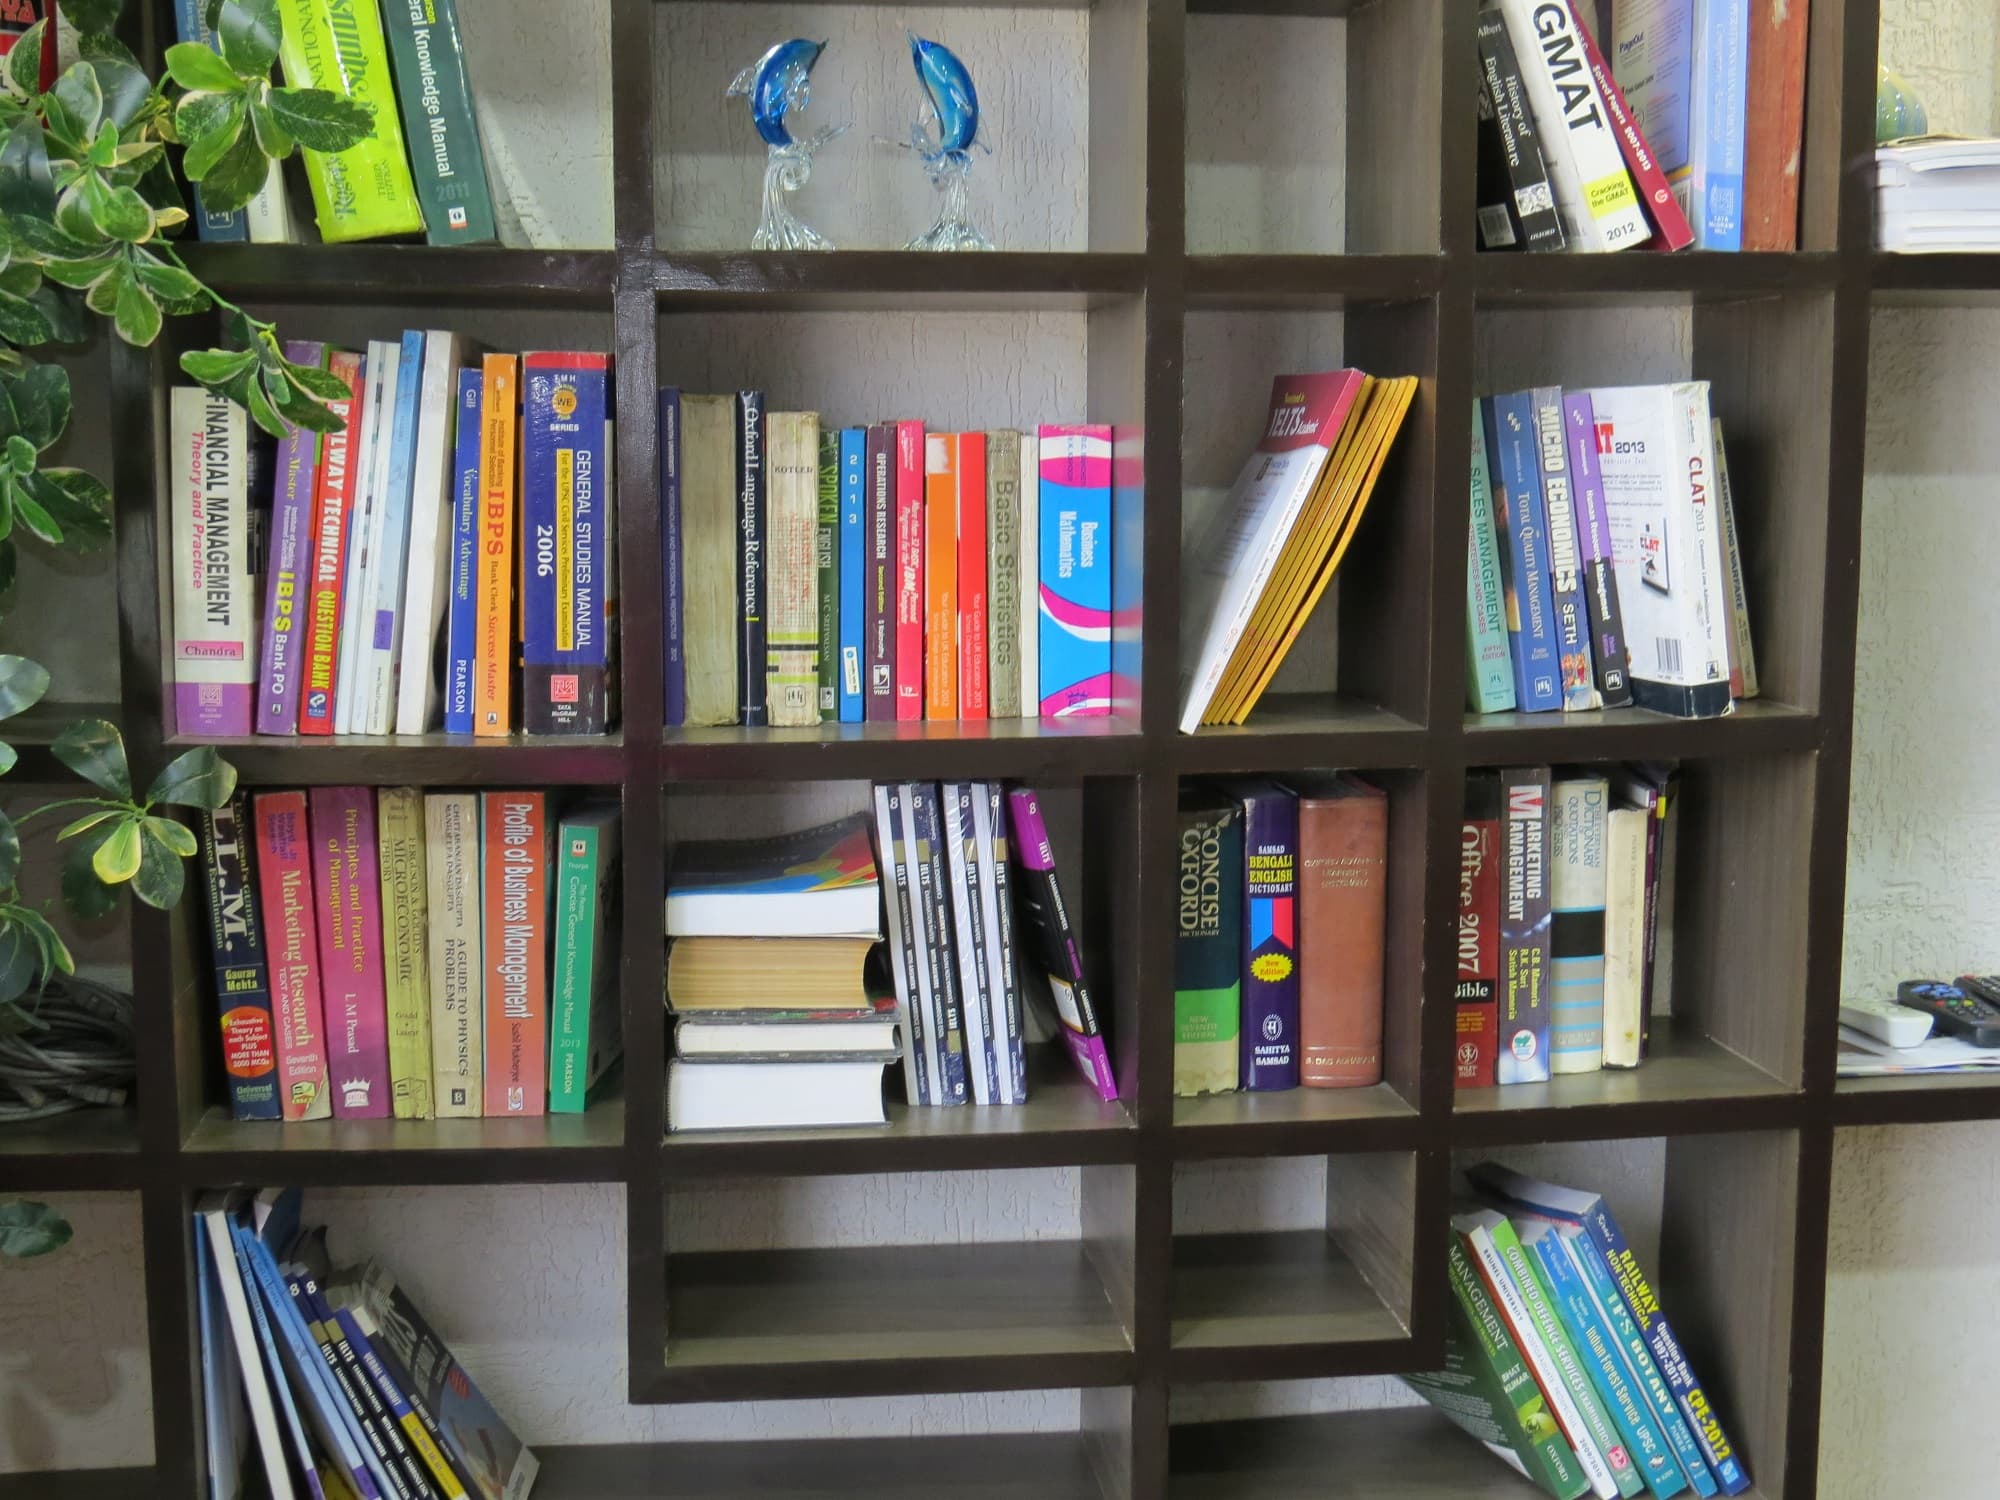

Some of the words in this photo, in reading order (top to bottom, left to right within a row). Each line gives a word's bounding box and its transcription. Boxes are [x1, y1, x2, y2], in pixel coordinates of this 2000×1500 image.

[1533, 3, 1605, 132] GMAT
[414, 30, 440, 117] Knowledge
[427, 116, 455, 178] Manual
[1485, 56, 1506, 105] English
[1496, 104, 1520, 167] Literature
[1505, 75, 1526, 122] History
[1517, 121, 1533, 137] of
[1591, 64, 1613, 95] Solved
[1602, 91, 1629, 126] Papers
[1623, 124, 1653, 172] 2007-2013
[1606, 222, 1636, 242] 2012
[464, 388, 476, 408] Gill
[205, 392, 231, 489] FINANCIAL
[324, 403, 350, 491] RILWAY
[742, 406, 760, 460] Oxford
[1539, 406, 1565, 473] MICRO
[1614, 441, 1646, 454] 2013
[189, 432, 205, 486] Theory
[560, 452, 570, 466] For
[560, 467, 570, 480] the
[875, 452, 888, 510] OPERATIONS
[1687, 455, 1706, 508] CLAT
[190, 490, 204, 519] and
[460, 467, 474, 534] Vocabulary
[560, 481, 570, 503] UPSC
[575, 450, 592, 518] GENERAL
[740, 462, 758, 538] Language
[819, 464, 838, 524] SPOKEN
[1584, 489, 1596, 520] Human
[486, 489, 504, 556] IBPS
[559, 504, 570, 523] Civil
[996, 481, 1014, 543] Basic
[1518, 491, 1532, 526] TOTAL
[1695, 508, 1705, 533] 2013
[191, 522, 204, 590] Practice
[317, 496, 342, 583] TECHNICAL
[536, 524, 553, 577] 2006
[559, 523, 570, 556] Services
[575, 521, 592, 585] STUDIES
[875, 511, 888, 560] RESEARCH
[1059, 510, 1078, 579] Mathematics
[1080, 521, 1099, 569] Business
[1469, 466, 1487, 518] SALES
[1479, 521, 1503, 633] MANAGEMENT
[1519, 526, 1538, 573] QUALITY
[1546, 474, 1578, 596] ECONOMICS
[1588, 520, 1603, 562] Resource
[1719, 471, 1737, 546] MARKETING
[1728, 545, 1745, 611] WARFARE
[205, 498, 231, 626] MANAGEMENT
[457, 538, 471, 601] Advantage
[557, 557, 570, 600] Preliminary
[743, 540, 758, 614] Reference
[273, 572, 296, 632] IBPS
[996, 554, 1013, 666] Statistics
[1525, 573, 1545, 640] MANAGEMENT
[1593, 562, 1612, 622] Management
[314, 590, 335, 654] QUESTION
[485, 615, 498, 659] Success
[559, 602, 570, 648] Examination
[574, 588, 592, 650] MANUAL
[1561, 602, 1578, 647] SETH
[183, 643, 237, 658] Chandra
[272, 634, 288, 671] Bank
[310, 655, 331, 690] BANK
[271, 673, 285, 695] PO
[454, 658, 466, 713] PEARSON
[485, 660, 496, 701] Master
[503, 802, 534, 848] Profile
[889, 796, 898, 809] 8
[912, 796, 922, 809] 8
[960, 796, 969, 809] 8
[990, 795, 1000, 809] 8
[1029, 802, 1037, 814] 8
[328, 838, 338, 854] of
[344, 808, 360, 881] Principles
[1258, 844, 1286, 854] SAMSAD
[1510, 784, 1542, 900] MARKETING
[1566, 796, 1578, 865] QUOTATIONS
[1583, 790, 1602, 868] DICTIONARY
[503, 848, 533, 866] of
[896, 863, 906, 887] IELTS
[919, 863, 930, 886] IELTS
[966, 863, 976, 886] IELTS
[996, 862, 1006, 885] IELTS
[1040, 841, 1052, 864] IELTS
[1248, 855, 1293, 869] BENGALI
[1461, 823, 1483, 909] Office
[349, 883, 360, 914] and
[503, 866, 534, 923] Business
[568, 875, 580, 912] Concise
[1180, 828, 1200, 930] OXFORD
[1201, 824, 1220, 930] CONCISE
[1248, 869, 1293, 883] ENGLISH
[1248, 883, 1293, 894] DICTIONARY
[281, 869, 305, 965] Marketing
[329, 855, 346, 950] Management
[394, 837, 410, 986] MICROECONOMIC
[352, 914, 364, 972] Practice
[457, 938, 467, 946] A
[566, 913, 578, 949] General
[1457, 912, 1480, 974] 2007
[225, 968, 256, 980] Gaurav
[278, 967, 288, 993] TEXT
[445, 937, 457, 1011] PROBLEMS
[457, 948, 467, 996] GUIDE
[496, 924, 535, 1019] Management
[564, 950, 576, 1000] Knowledge
[1259, 967, 1285, 976] Edition
[1264, 960, 1281, 968] New
[1508, 949, 1518, 982] Satish
[1518, 969, 1528, 989] Suri
[1519, 948, 1528, 968] R.K.
[1531, 947, 1541, 969] C.B.
[226, 979, 258, 992] Mehta
[281, 994, 290, 1015] AND
[288, 964, 313, 1048] Research
[345, 993, 356, 1001] L
[458, 999, 468, 1017] TO
[1507, 982, 1517, 1021] Mamoria
[1530, 971, 1541, 1008] Mamoria
[283, 1015, 293, 1049] CASES
[345, 1002, 357, 1019] M
[562, 1001, 573, 1034] Manual
[346, 1020, 360, 1054] Prasad
[458, 1020, 469, 1077] PHYSICS
[559, 1039, 581, 1049] 2013
[1254, 1044, 1290, 1055] SAHITYA
[288, 1064, 317, 1076] Edition
[562, 1052, 573, 1095] PEARSON
[1255, 1055, 1290, 1066] SAMSAD
[1448, 1244, 1510, 1351] MANAGEMENT
[1496, 1272, 1525, 1323] UNIVERSITY
[1606, 1248, 1622, 1270] NON
[1614, 1267, 1651, 1332] TECHNICAL
[1619, 1249, 1660, 1314] RAILWAY
[1606, 1292, 1635, 1336] IFS
[320, 1343, 336, 1366] IELTS
[338, 1340, 354, 1363] IELTS
[1505, 1245, 1539, 1311] COMBINED
[1533, 1300, 1561, 1346] DEFENCE
[1553, 1341, 1586, 1398] SERVICES
[1579, 1391, 1612, 1450] EXAMINATION
[1652, 1337, 1683, 1387] 1997-2012
[1656, 1320, 1686, 1364] Question
[1675, 1360, 1694, 1387] Bank
[1501, 1364, 1522, 1382] BHAT
[1585, 1325, 1607, 1359] Indian
[1597, 1354, 1621, 1389] Forest
[1614, 1384, 1642, 1427] Service
[1636, 1424, 1656, 1455] UPSC
[1629, 1341, 1675, 1415] BOTANY
[1686, 1388, 1731, 1460] CPE-2012
[1545, 1443, 1570, 1484] OXFORD
